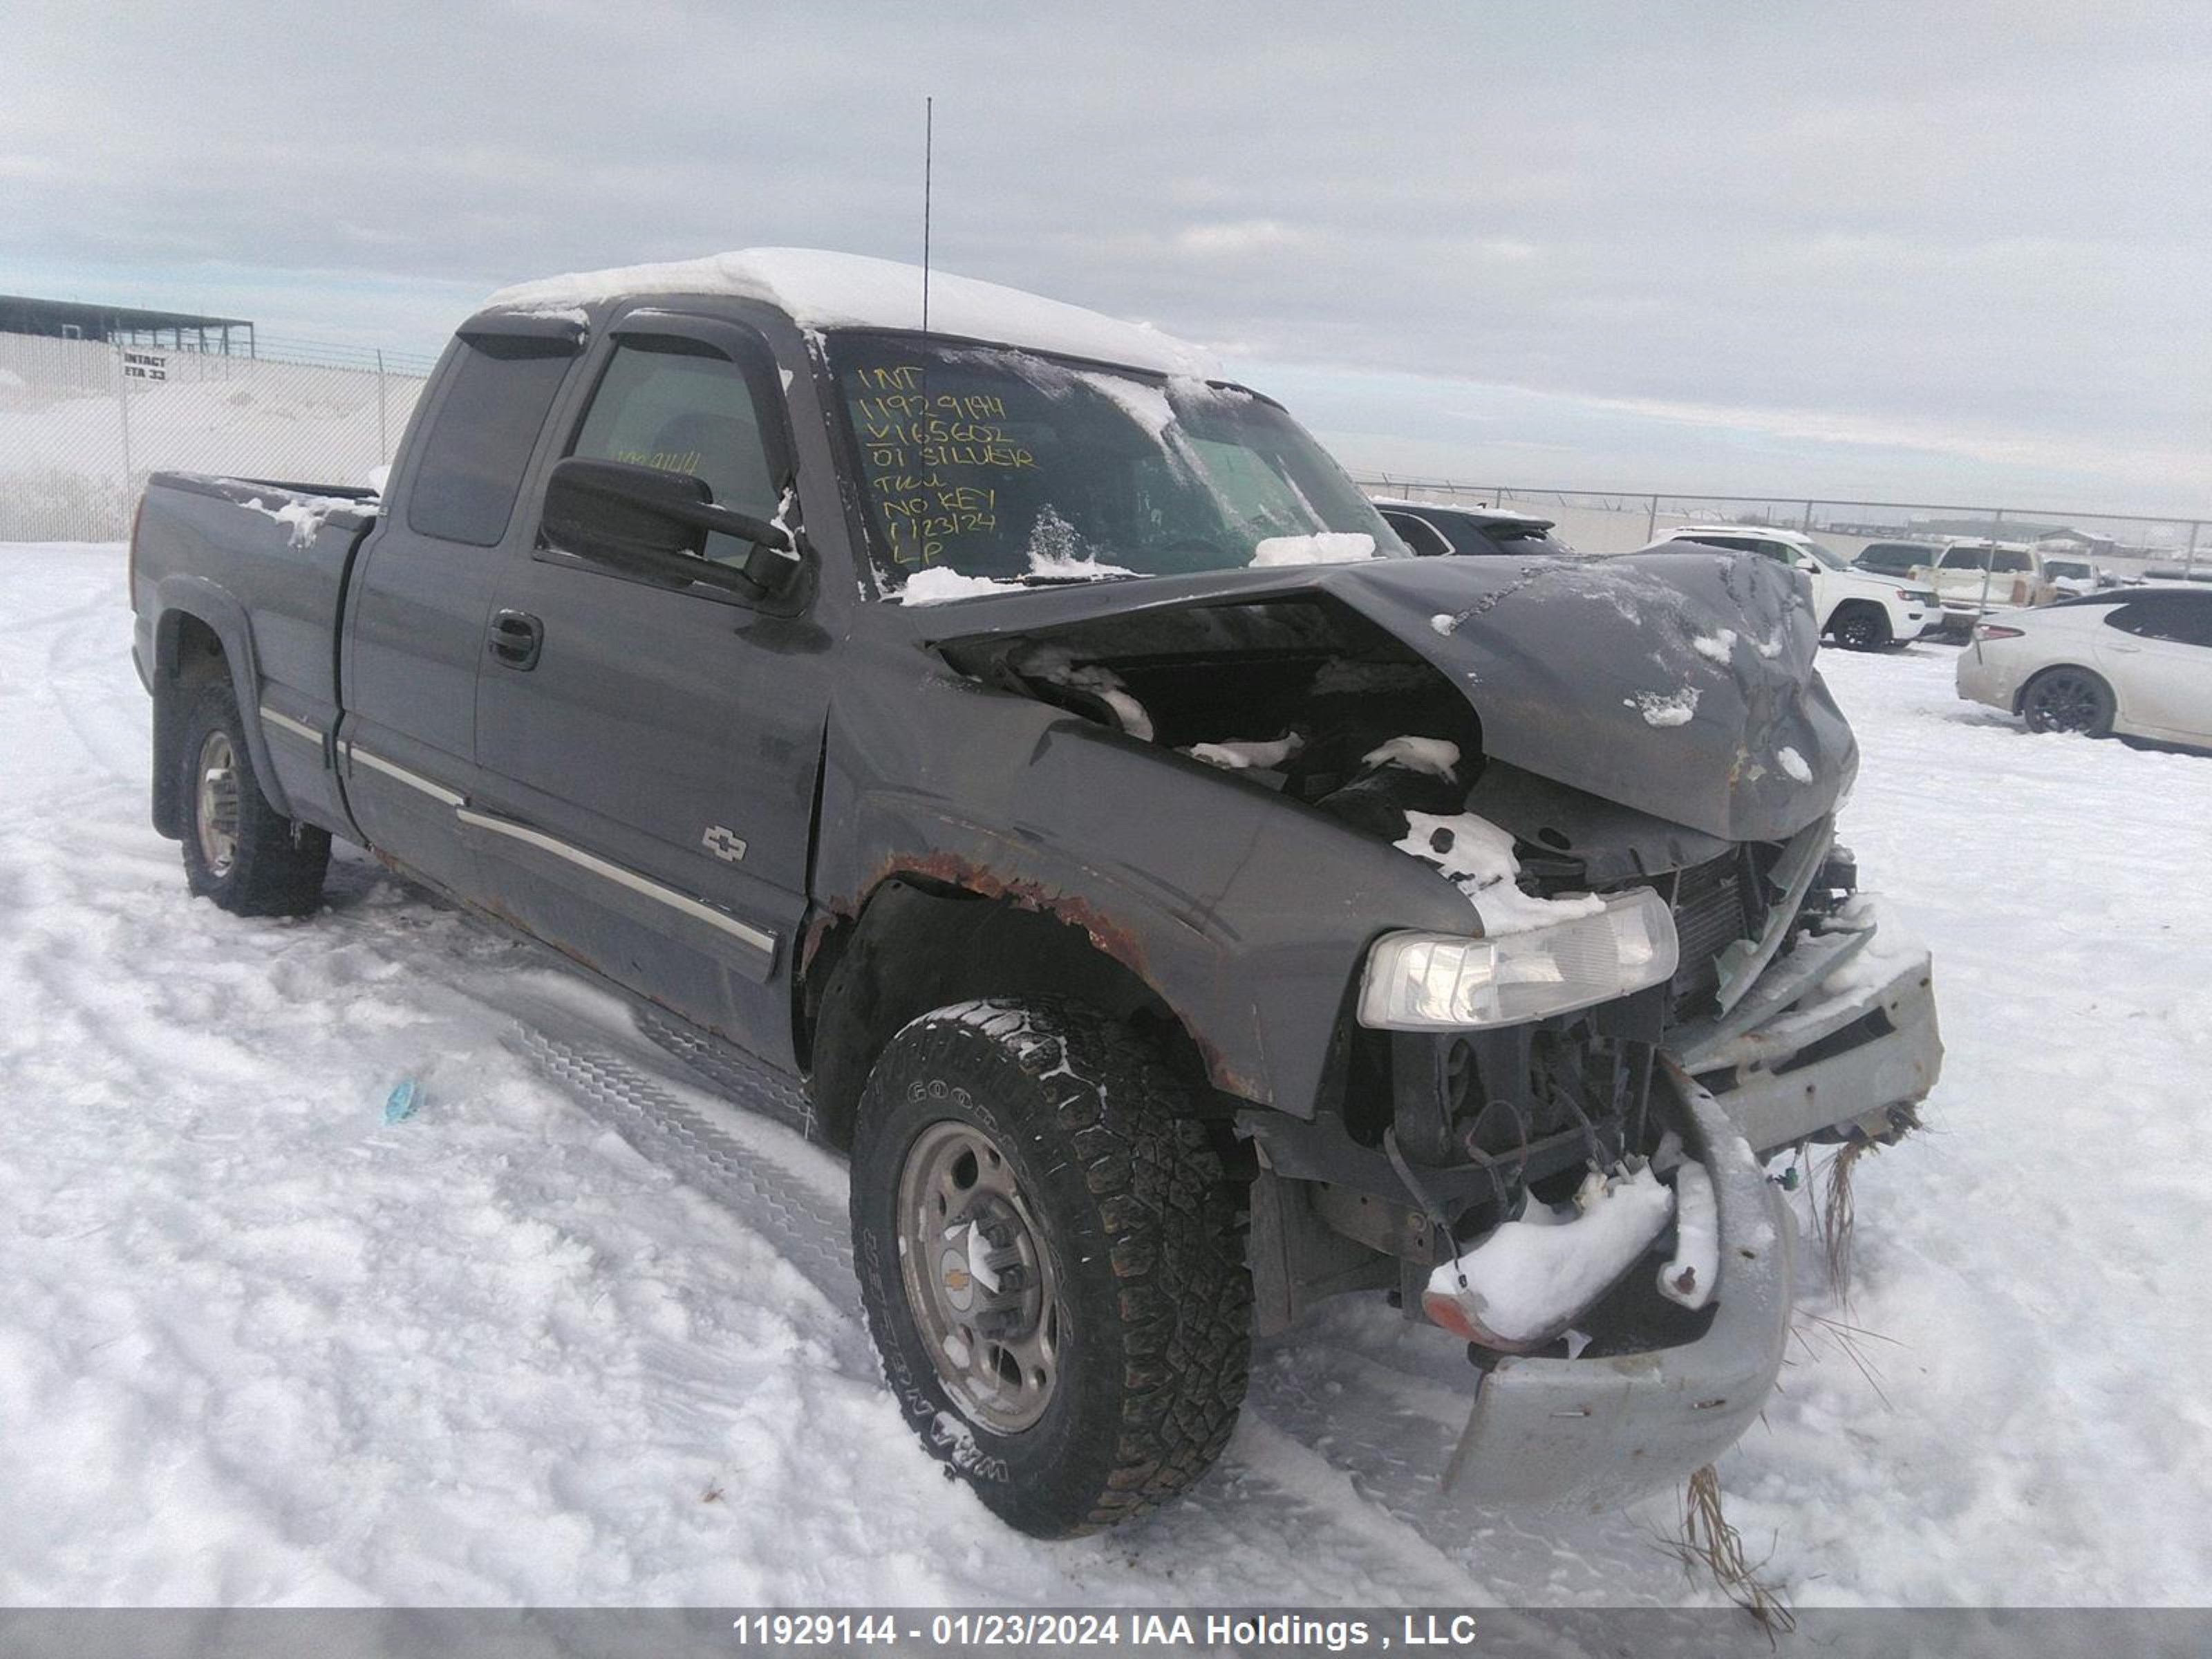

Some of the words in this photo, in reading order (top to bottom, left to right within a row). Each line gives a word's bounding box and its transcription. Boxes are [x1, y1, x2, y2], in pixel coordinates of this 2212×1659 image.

[149, 369, 166, 380] 33
[858, 366, 924, 389] INT
[883, 498, 928, 519] NO
[937, 487, 994, 511] KEY
